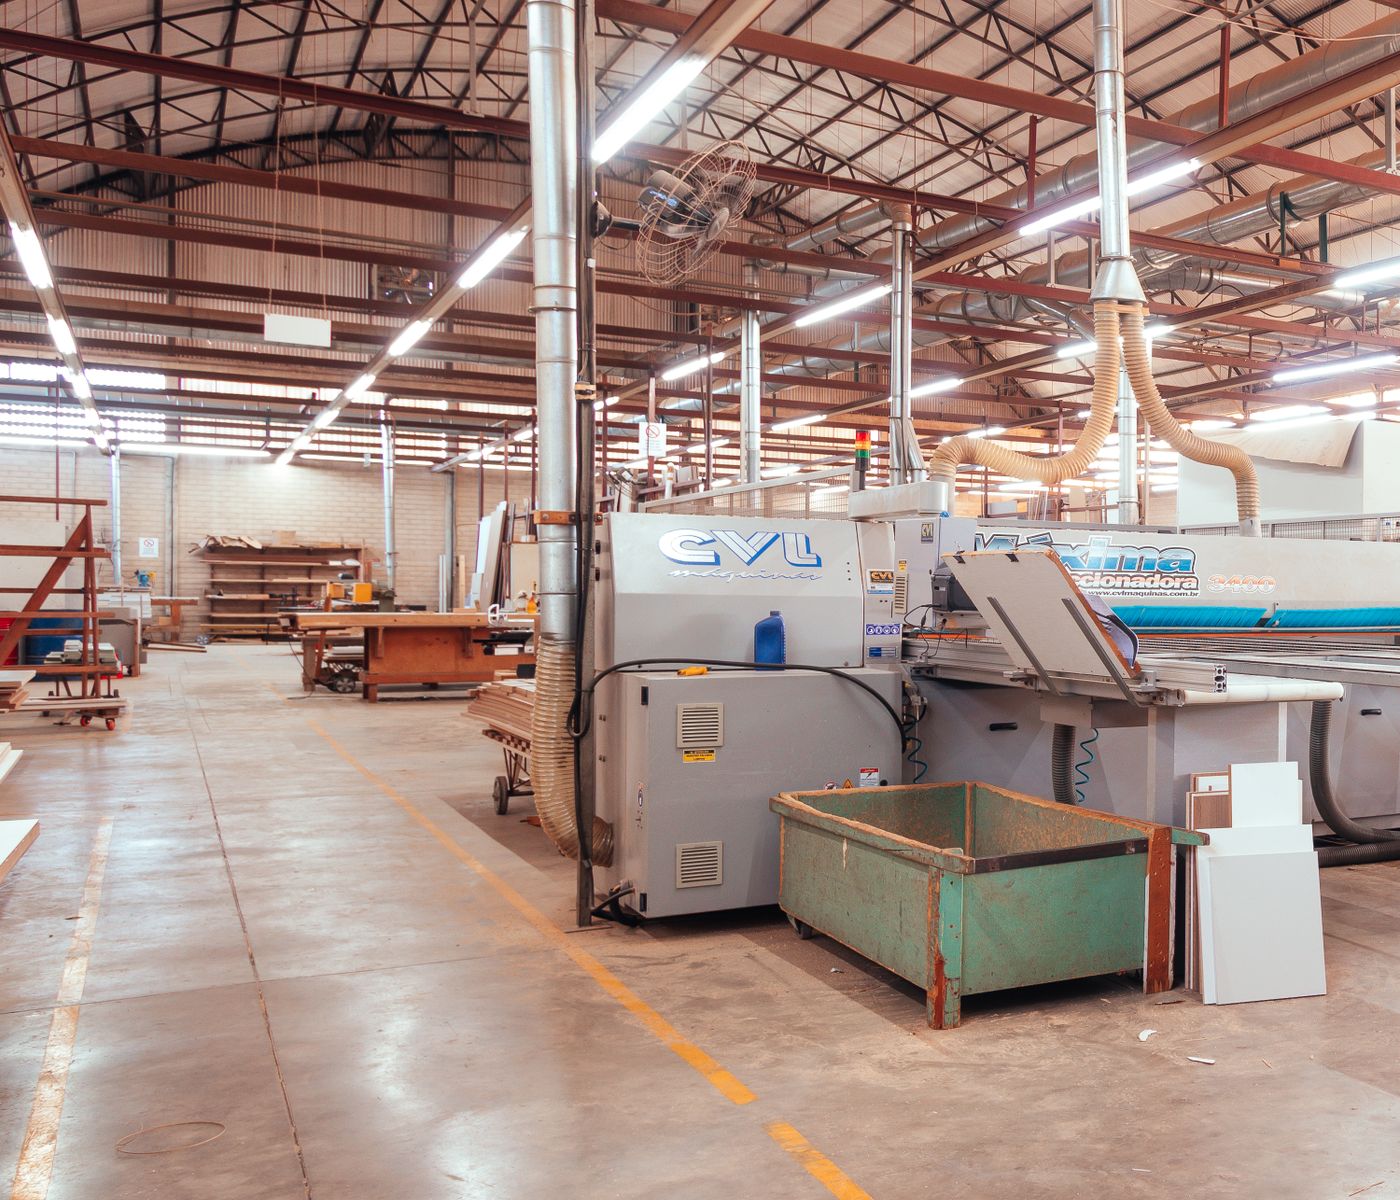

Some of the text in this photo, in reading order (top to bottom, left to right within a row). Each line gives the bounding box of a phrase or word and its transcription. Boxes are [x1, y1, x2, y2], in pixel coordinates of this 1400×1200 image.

[658, 528, 822, 567] CVL
[974, 531, 1196, 574] xima
[1069, 573, 1198, 590] ccionadora
[1208, 574, 1276, 593] 3400
